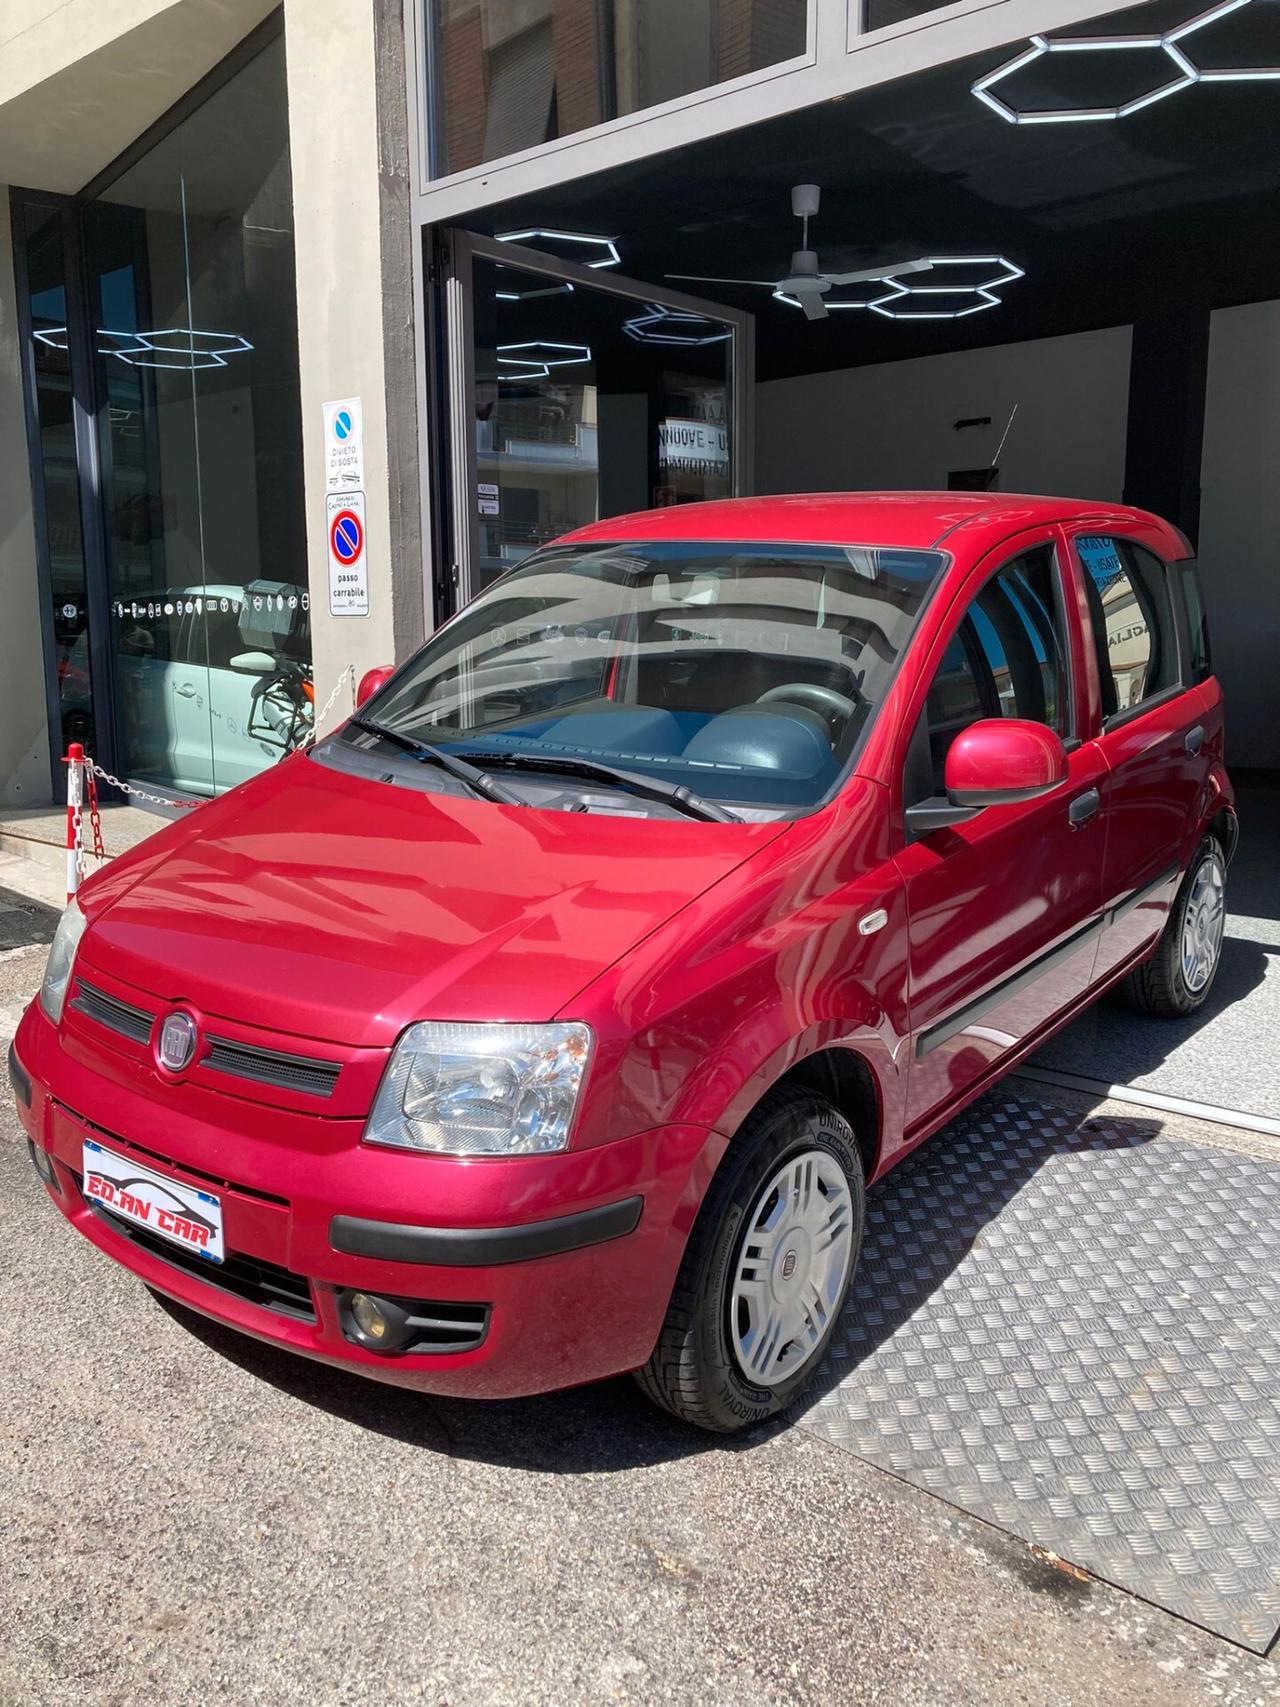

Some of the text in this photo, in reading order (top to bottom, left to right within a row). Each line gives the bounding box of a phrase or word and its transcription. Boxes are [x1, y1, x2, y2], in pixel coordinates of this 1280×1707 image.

[332, 446, 356, 456] DIVIETO
[338, 457, 358, 466] SOSTA
[338, 574, 358, 584] passo
[333, 587, 364, 597] carrabile
[154, 1205, 210, 1248] CAR
[719, 1381, 770, 1420] UNIROYAL
